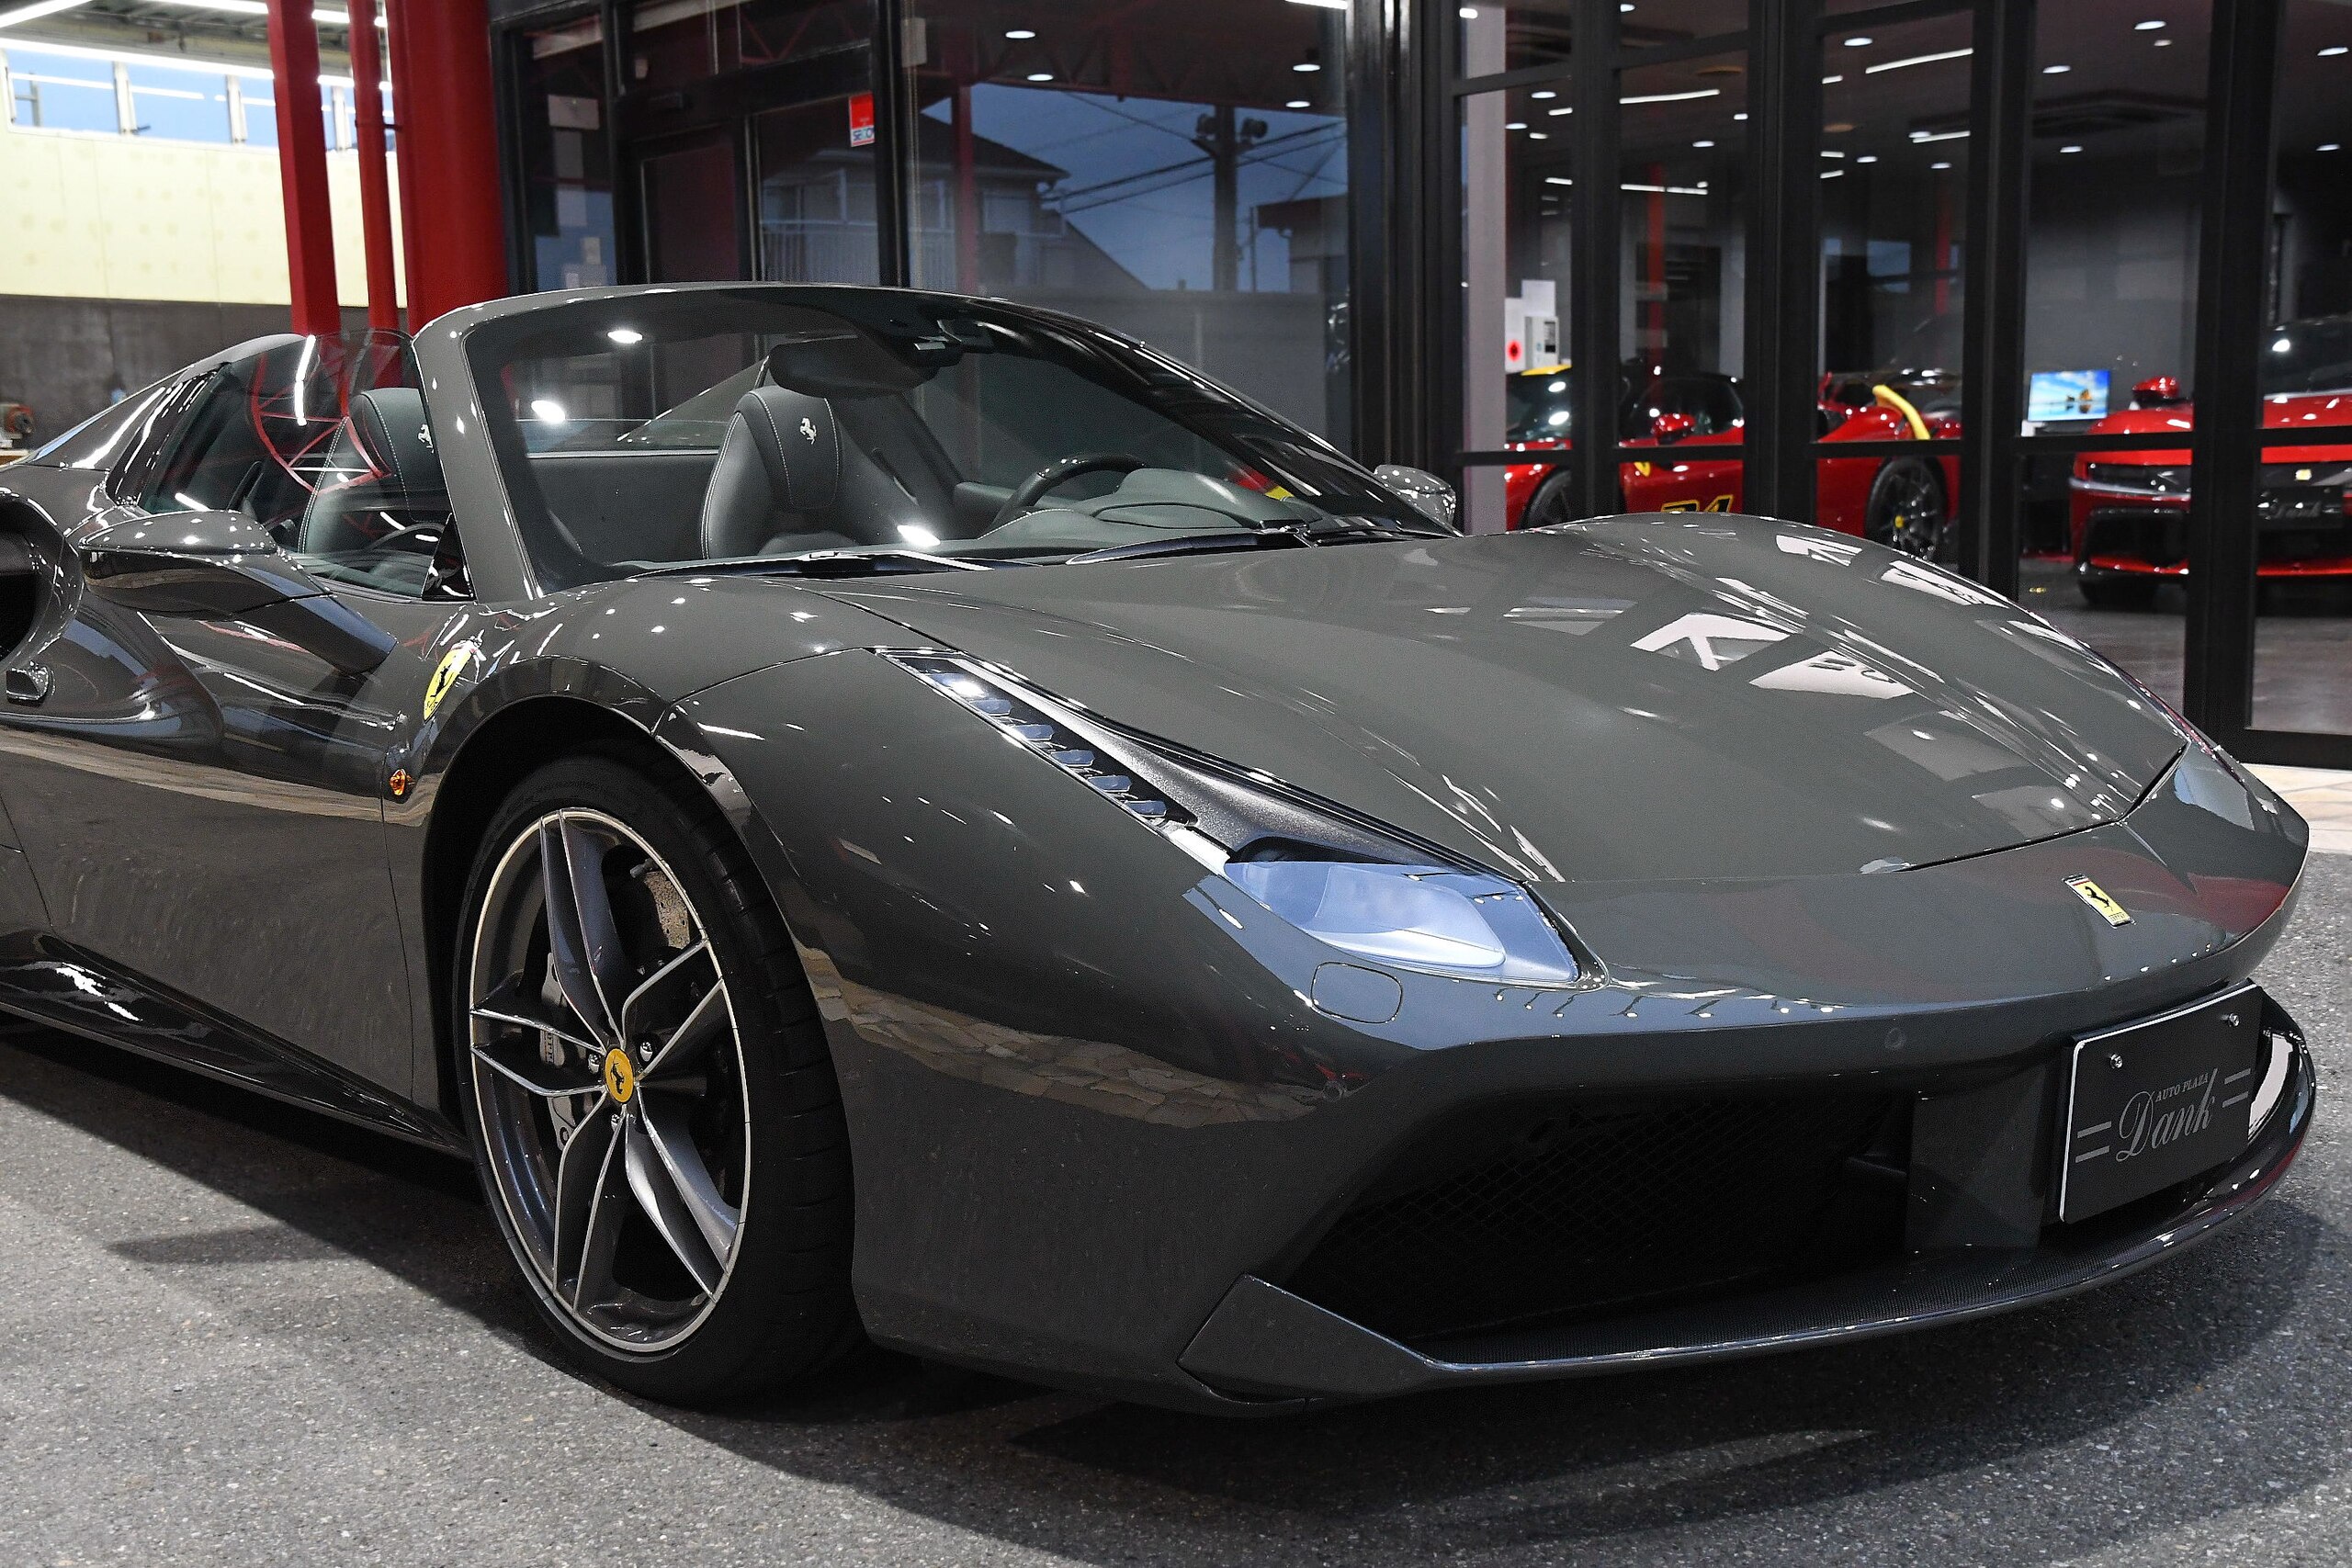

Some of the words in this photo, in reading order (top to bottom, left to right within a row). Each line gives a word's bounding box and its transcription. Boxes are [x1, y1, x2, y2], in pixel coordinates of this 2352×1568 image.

[2116, 1067, 2219, 1162] Dank
[2155, 1084, 2181, 1102] AUTO
[2182, 1073, 2209, 1092] PLAZA
